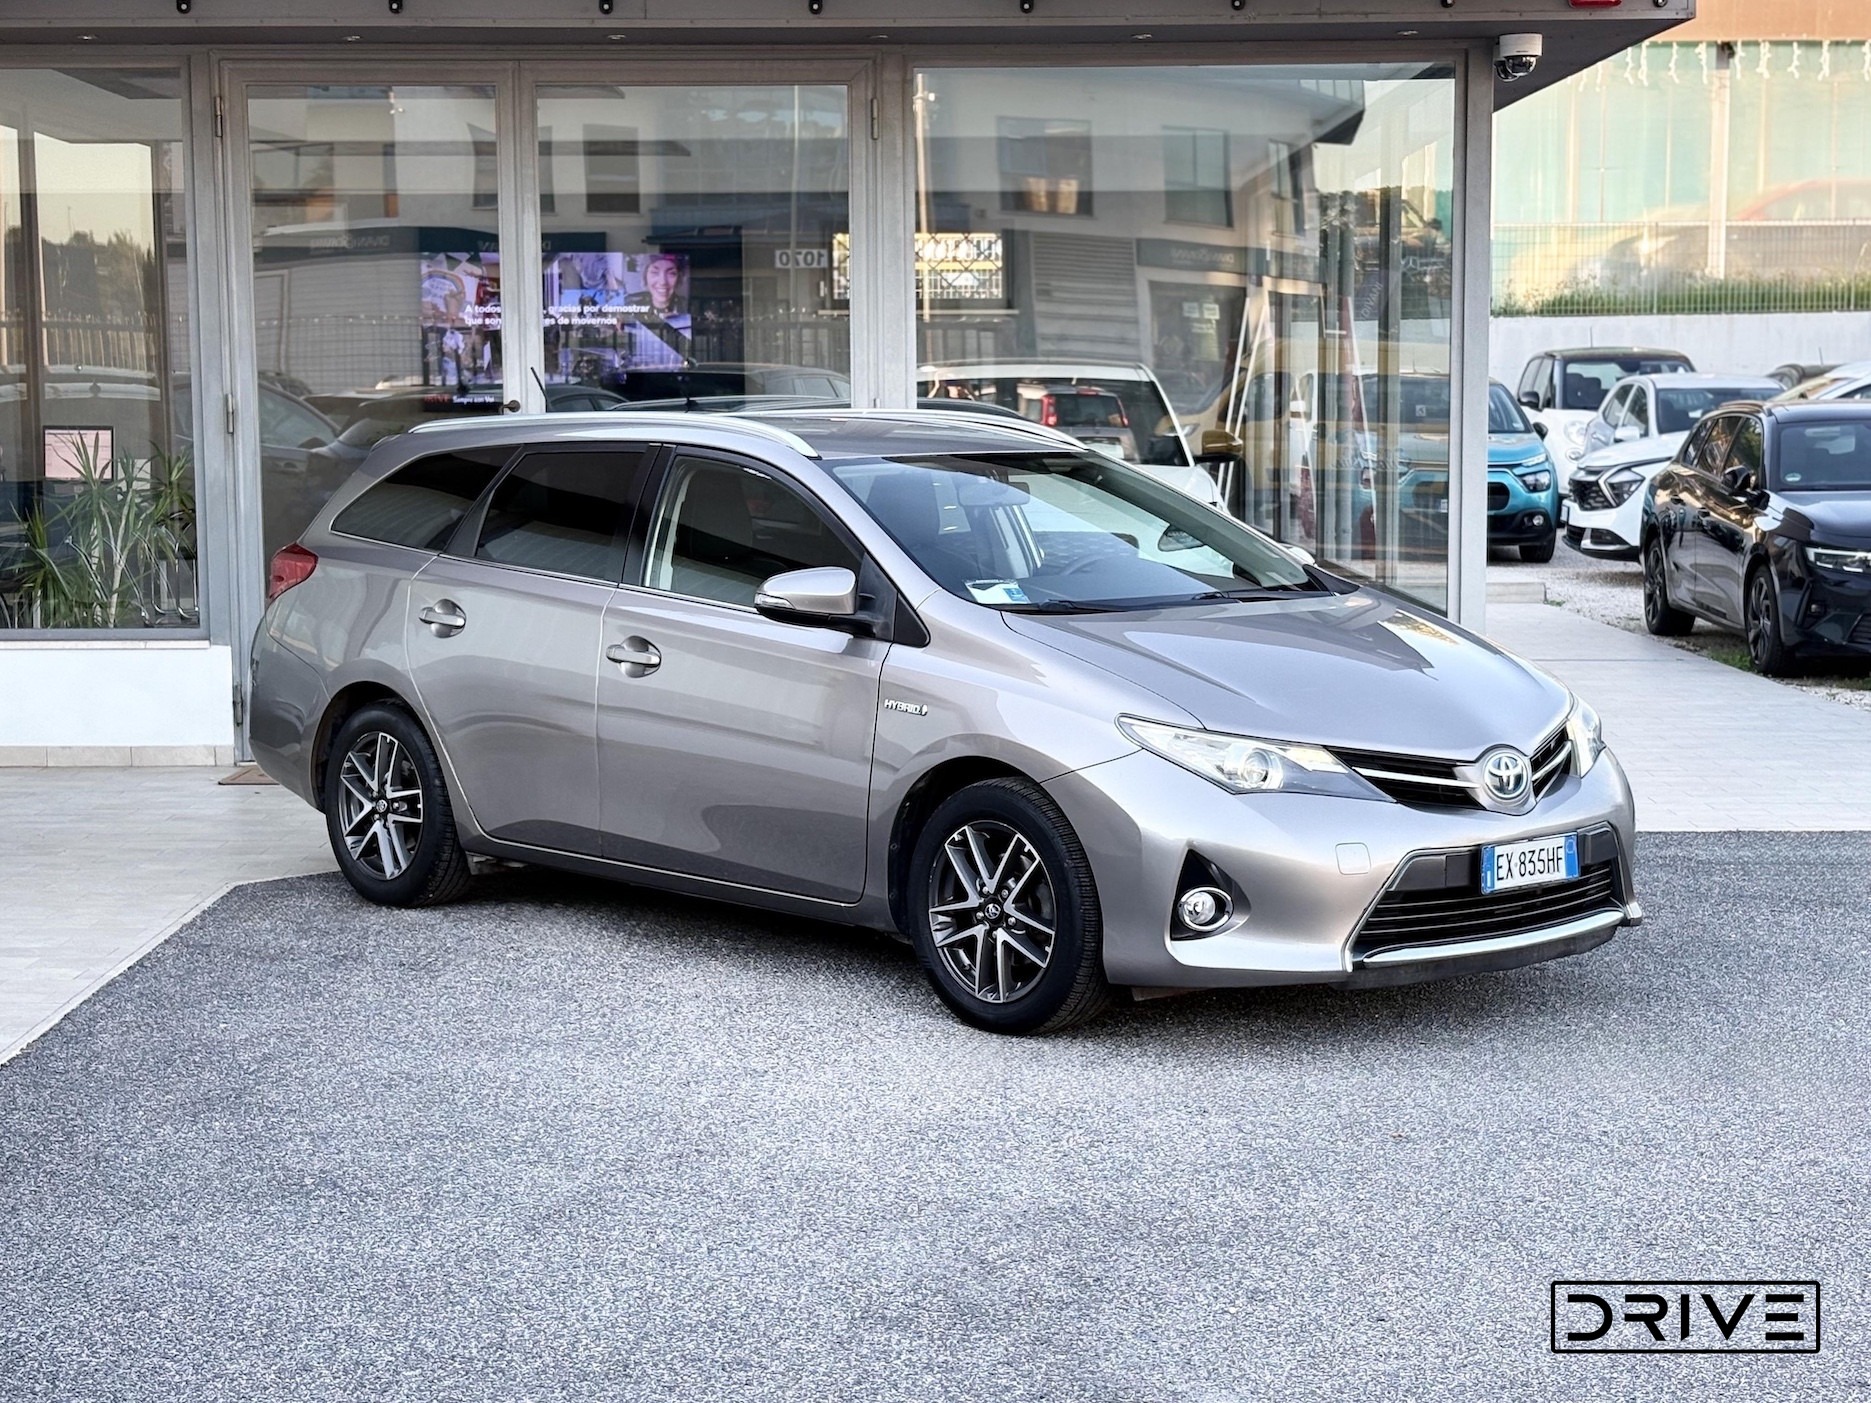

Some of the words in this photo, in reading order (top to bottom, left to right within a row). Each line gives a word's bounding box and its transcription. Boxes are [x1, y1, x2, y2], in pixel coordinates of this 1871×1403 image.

[464, 305, 473, 313] A
[548, 304, 581, 315] gracias
[583, 305, 600, 314] por
[602, 304, 650, 313] demostrar
[464, 317, 484, 327] que
[557, 316, 570, 325] de
[884, 699, 920, 714] HYBRID
[1496, 851, 1514, 881] EX
[1518, 846, 1563, 877] 835HF
